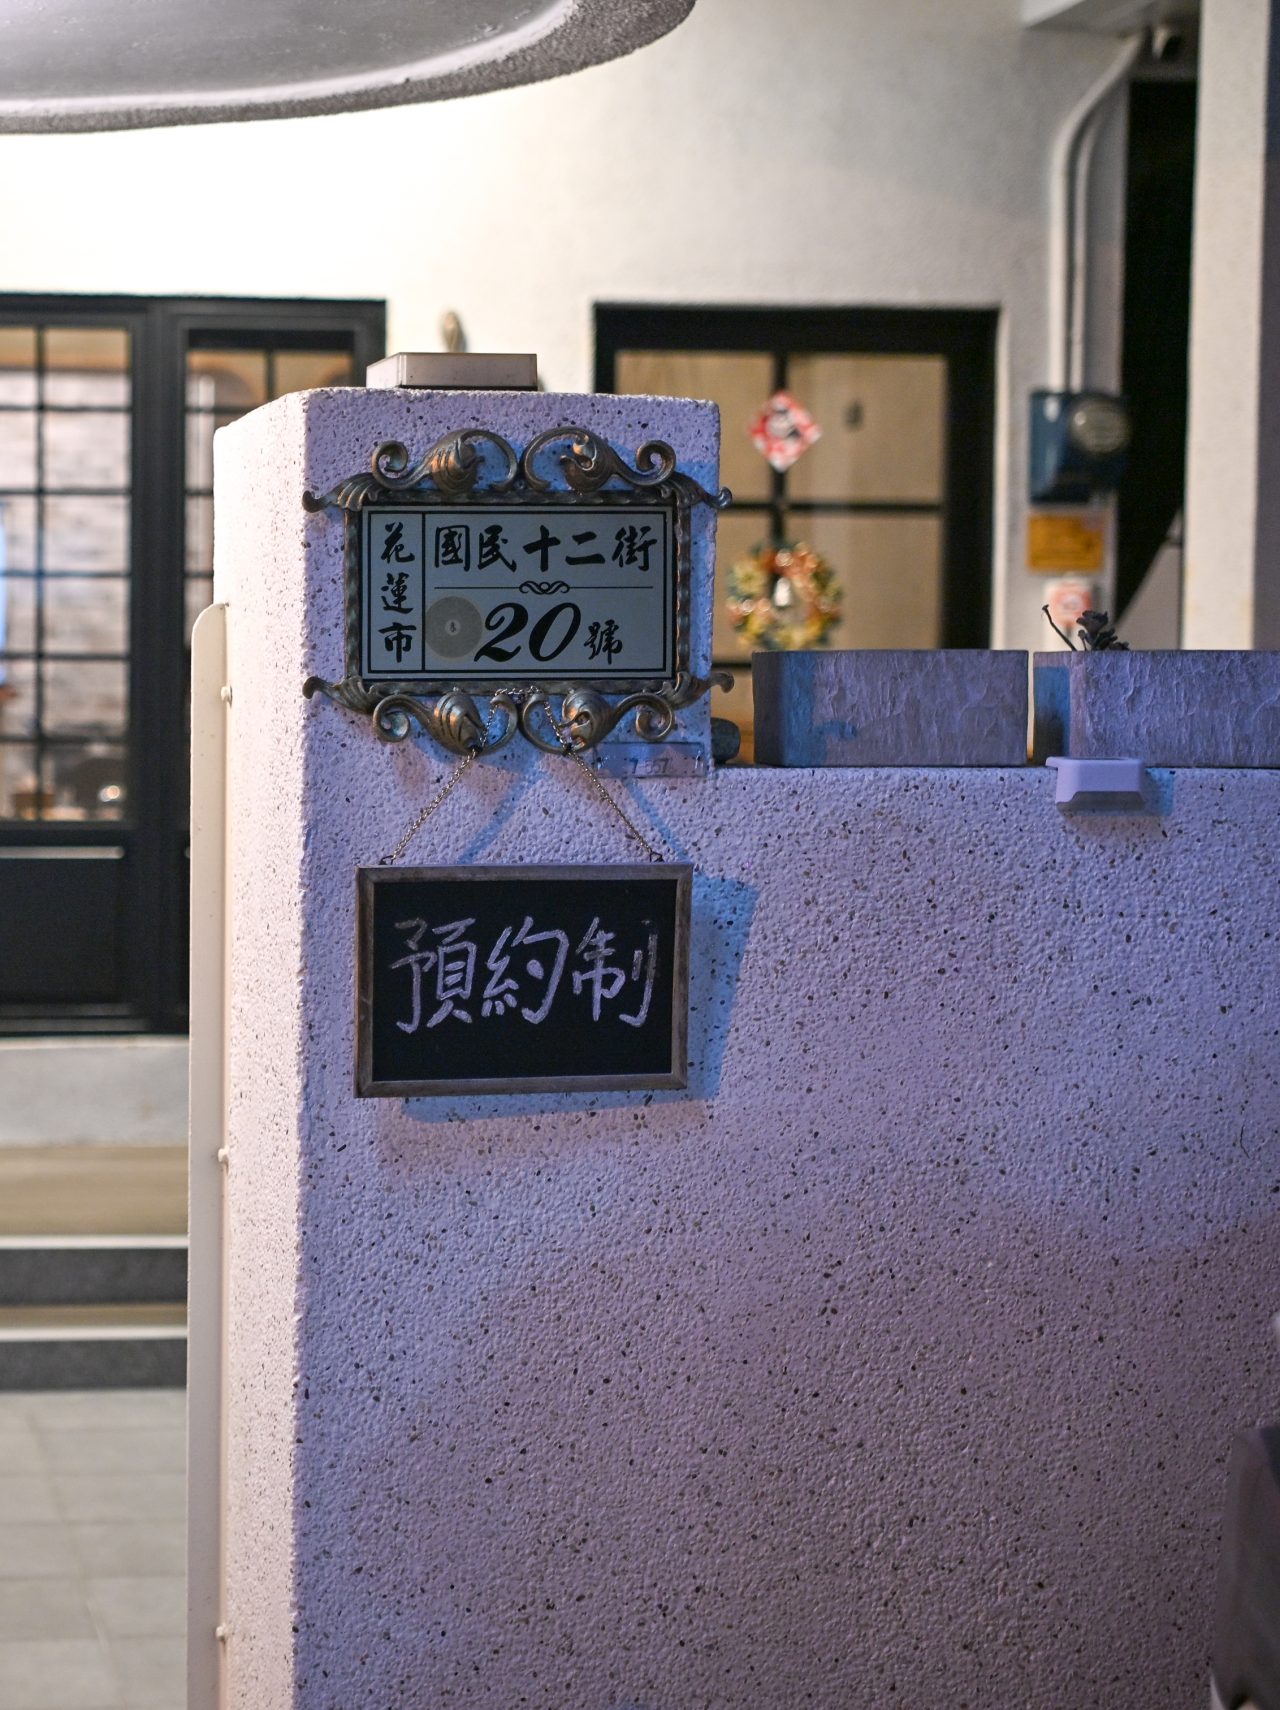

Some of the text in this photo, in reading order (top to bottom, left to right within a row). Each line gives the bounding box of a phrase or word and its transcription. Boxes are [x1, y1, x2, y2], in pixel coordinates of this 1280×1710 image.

[378, 521, 417, 663] 花蓮市
[434, 523, 658, 573] 國民十二街
[473, 601, 624, 666] 20號
[391, 915, 659, 1034] 預約制
